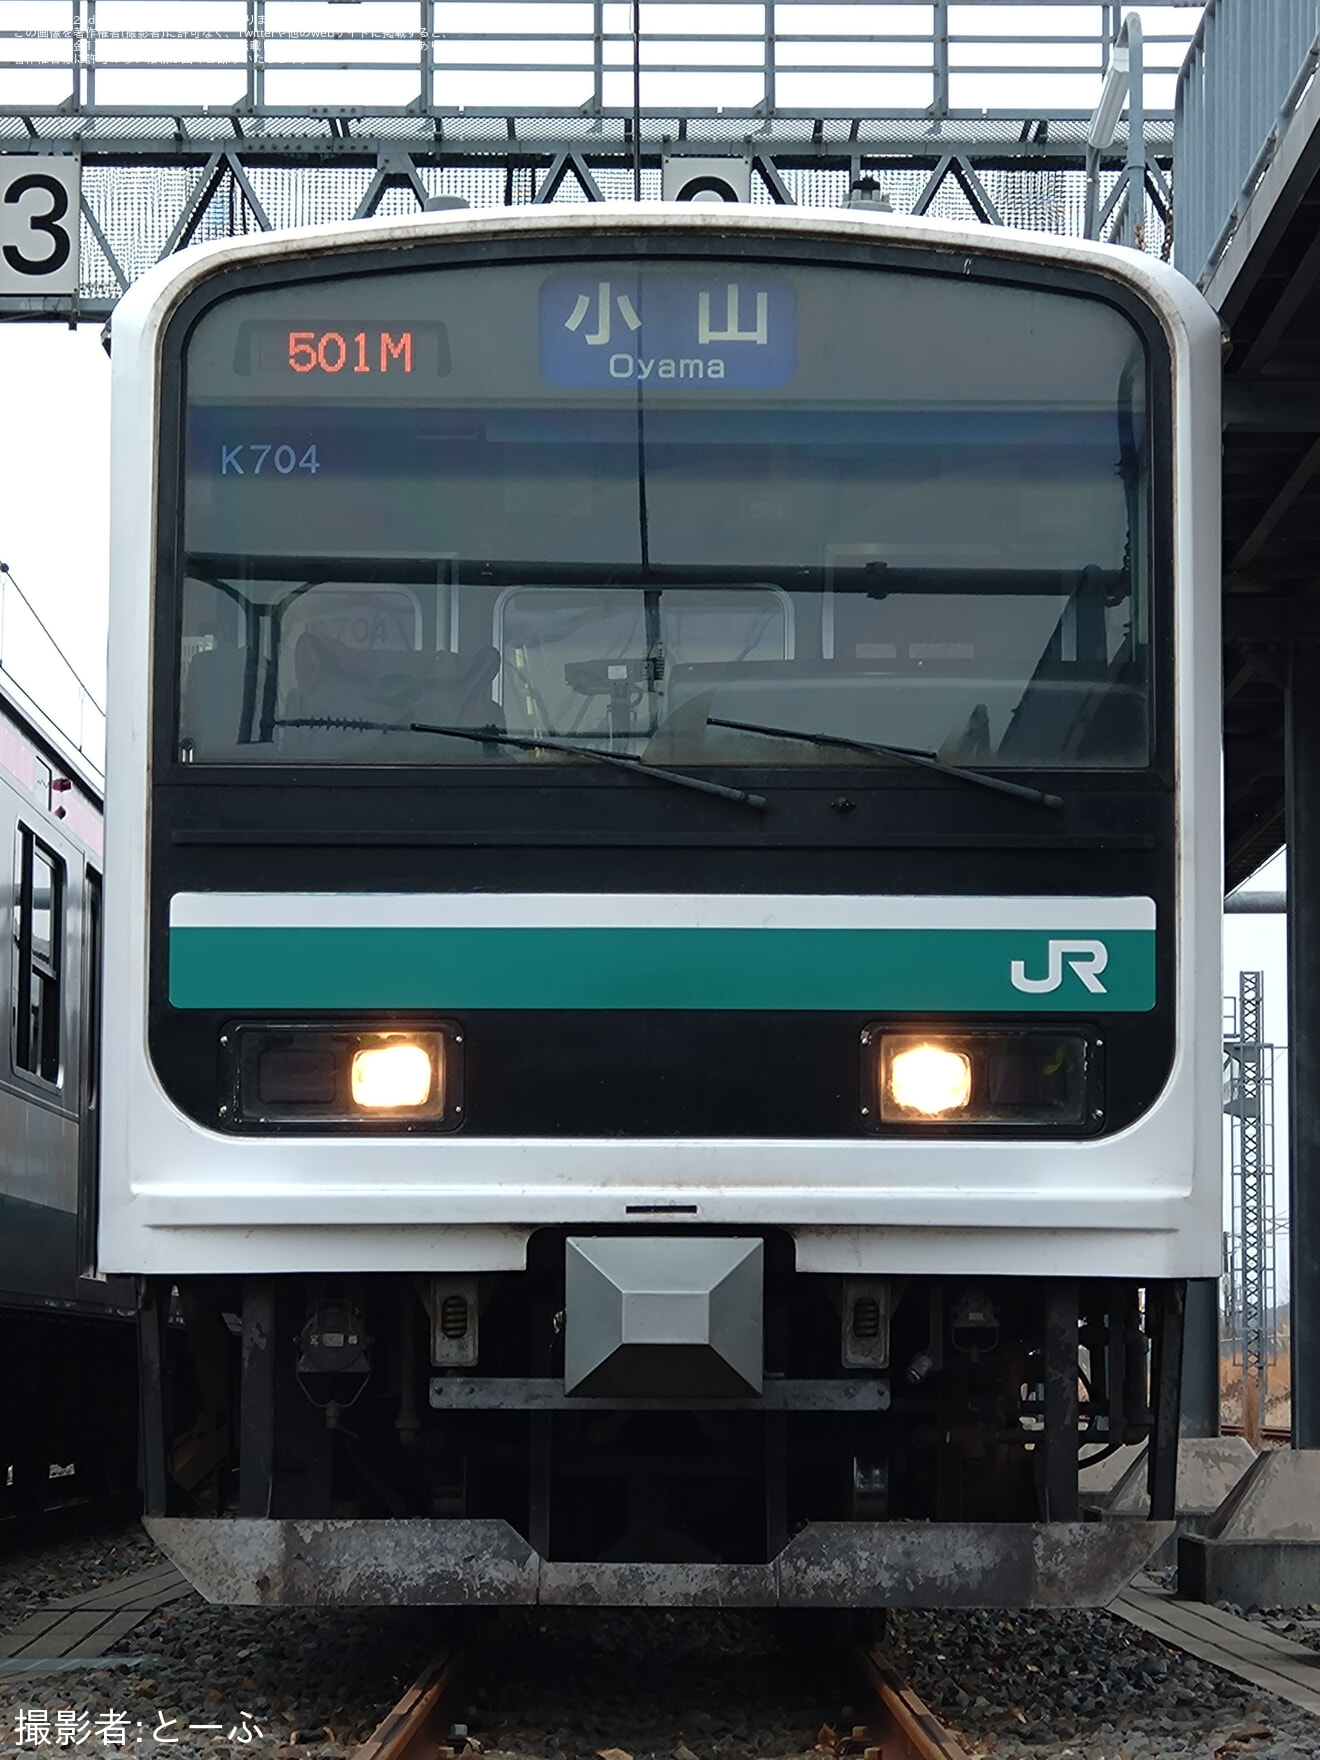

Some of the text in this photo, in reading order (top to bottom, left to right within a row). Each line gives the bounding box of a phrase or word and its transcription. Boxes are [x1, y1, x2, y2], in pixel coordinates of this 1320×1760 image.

[2, 173, 71, 275] 3
[565, 282, 768, 345] 小山
[288, 332, 412, 373] 501M
[609, 353, 725, 380] Oyama
[221, 444, 320, 475] K704
[1011, 940, 1108, 993] JR
